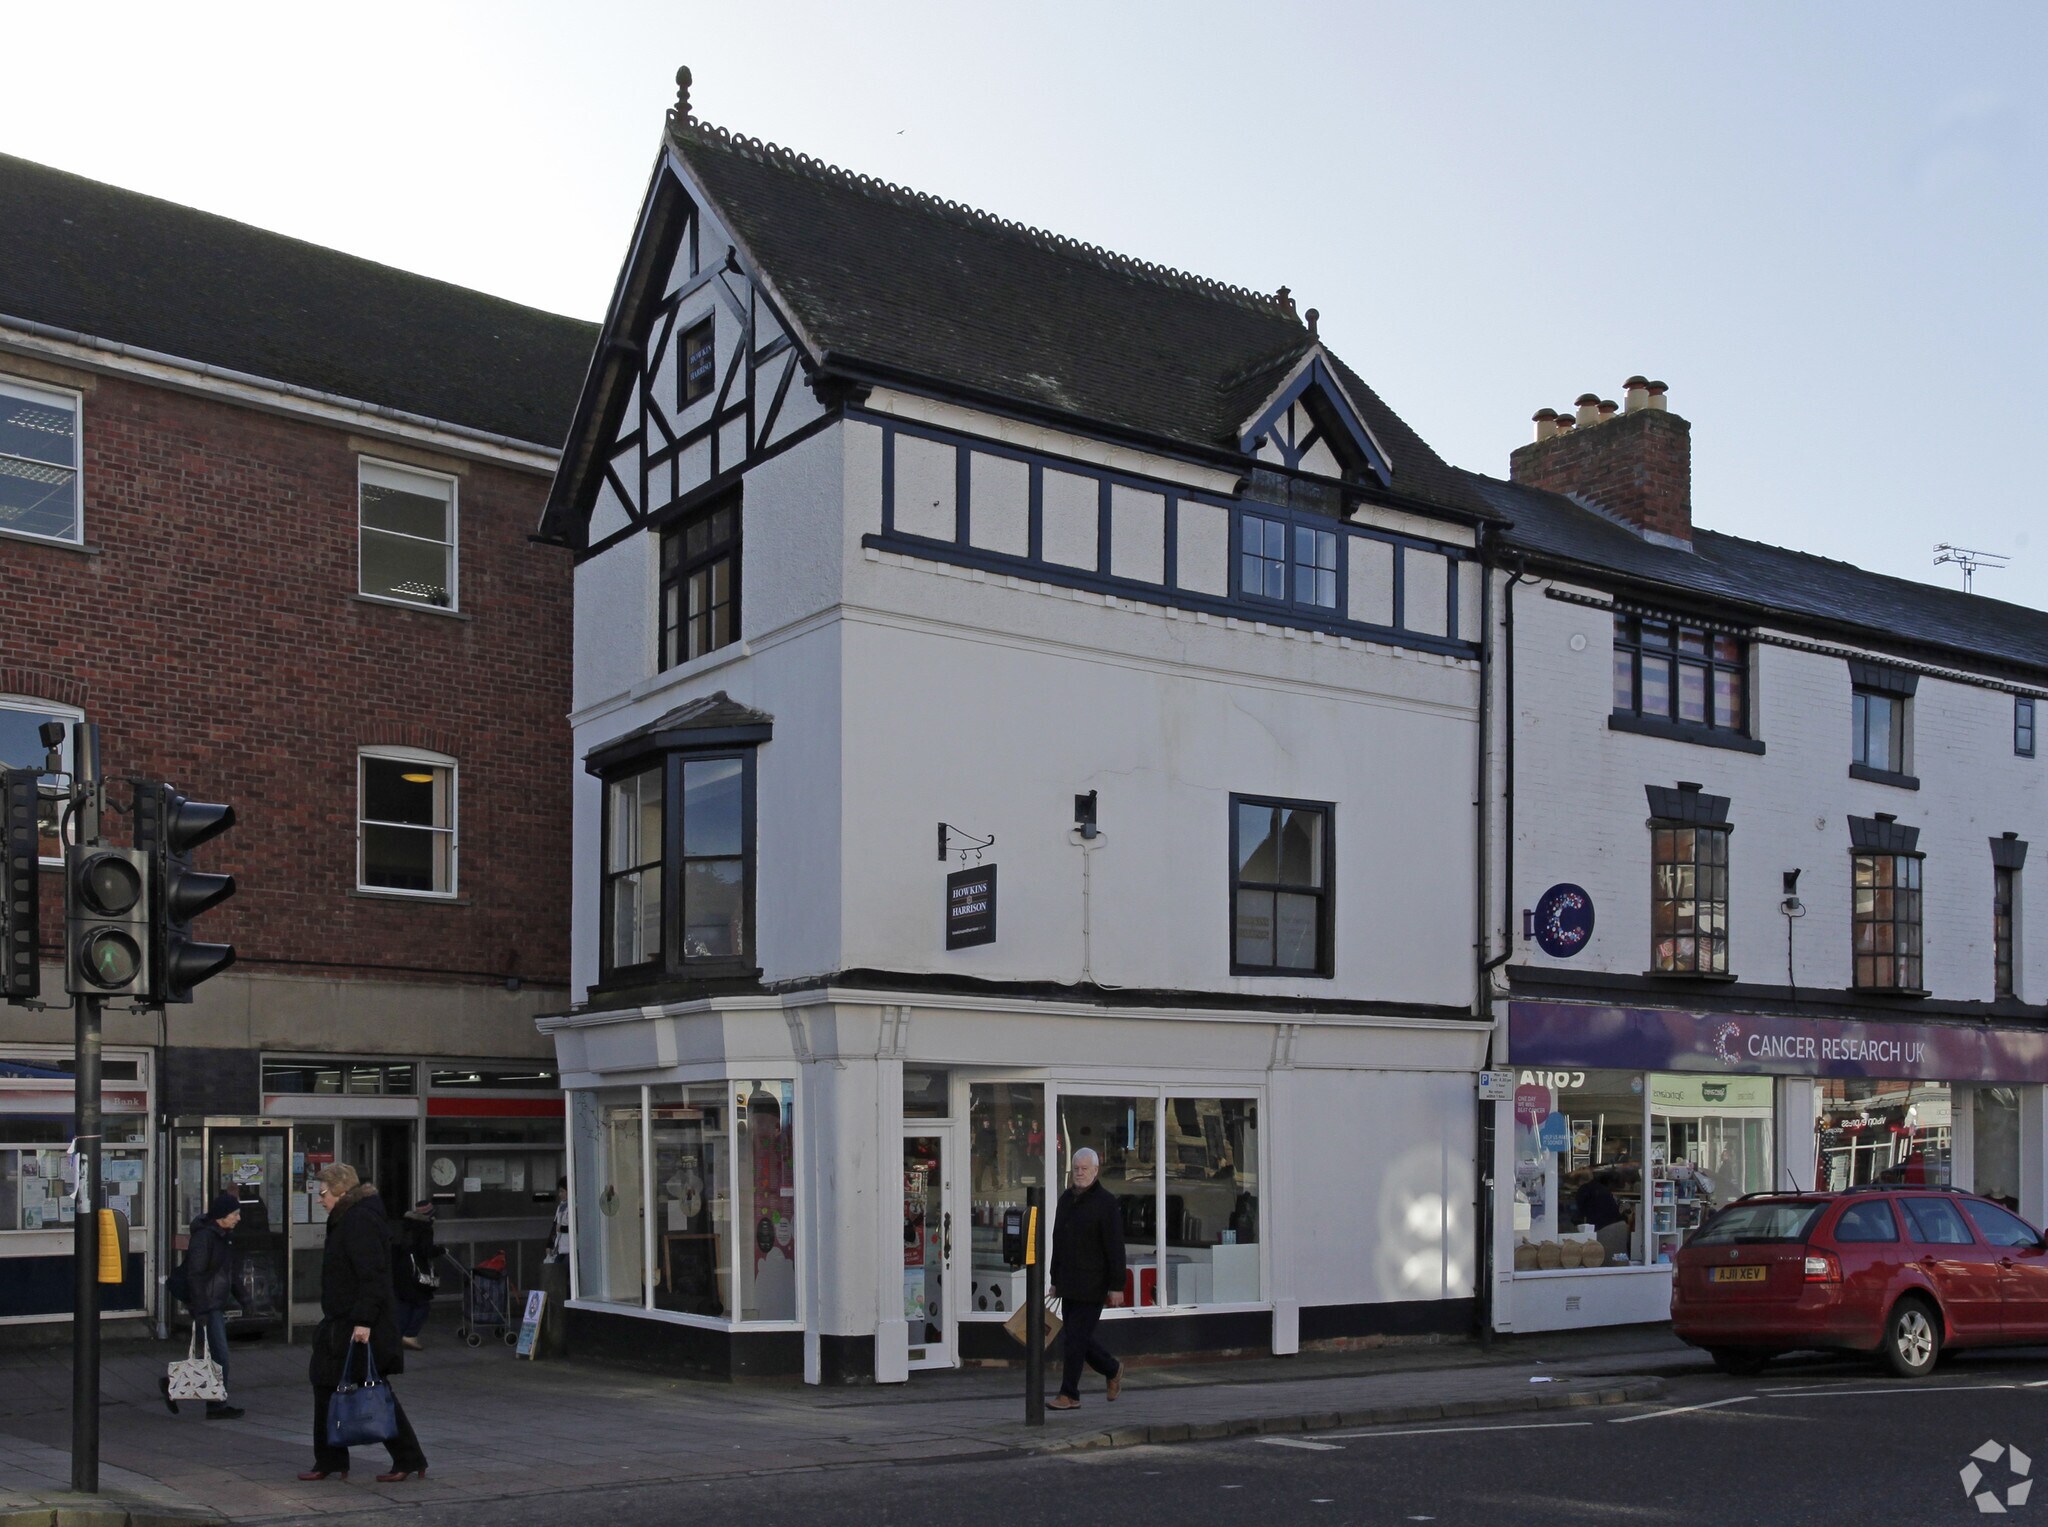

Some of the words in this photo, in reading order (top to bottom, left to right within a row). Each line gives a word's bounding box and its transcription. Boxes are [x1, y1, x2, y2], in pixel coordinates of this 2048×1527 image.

[953, 883, 987, 898] HOWKINS
[952, 902, 986, 916] HARRISON
[1747, 1034, 1815, 1058] CANCER
[1822, 1038, 1901, 1062] RESEARCH
[1905, 1042, 1925, 1063] UK
[113, 1097, 139, 1105] Bank
[1719, 1268, 1738, 1279] AJ11
[1740, 1268, 1760, 1279] XEV
